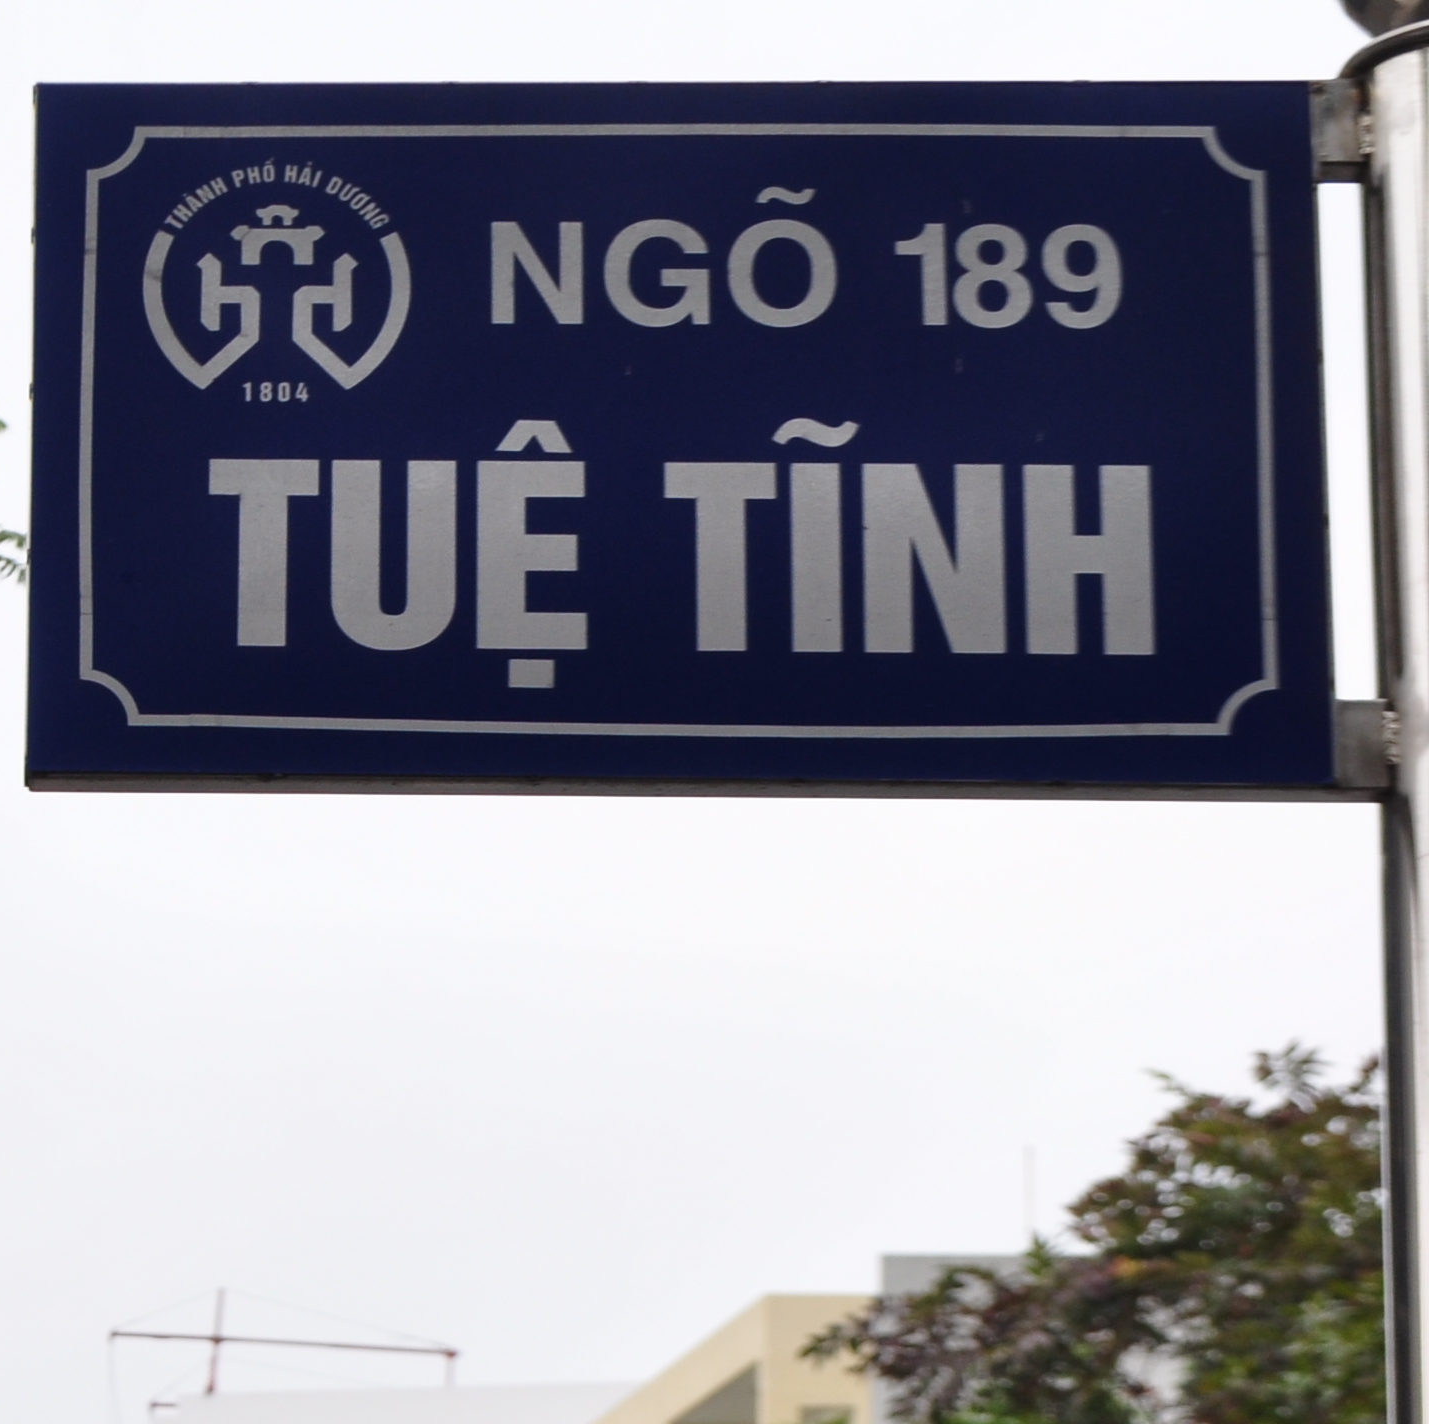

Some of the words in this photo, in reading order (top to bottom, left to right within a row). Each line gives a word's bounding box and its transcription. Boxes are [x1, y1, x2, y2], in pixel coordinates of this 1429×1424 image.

[164, 176, 228, 230] THÀNH
[231, 157, 275, 188] PHỐ
[284, 161, 322, 188] HẢI
[325, 176, 390, 230] DƯƠNG
[492, 187, 837, 328] NGÕ
[895, 222, 1122, 329] 189
[242, 381, 309, 402] 1804
[208, 419, 588, 688] TUỆ
[663, 417, 1155, 656] TĨNH
